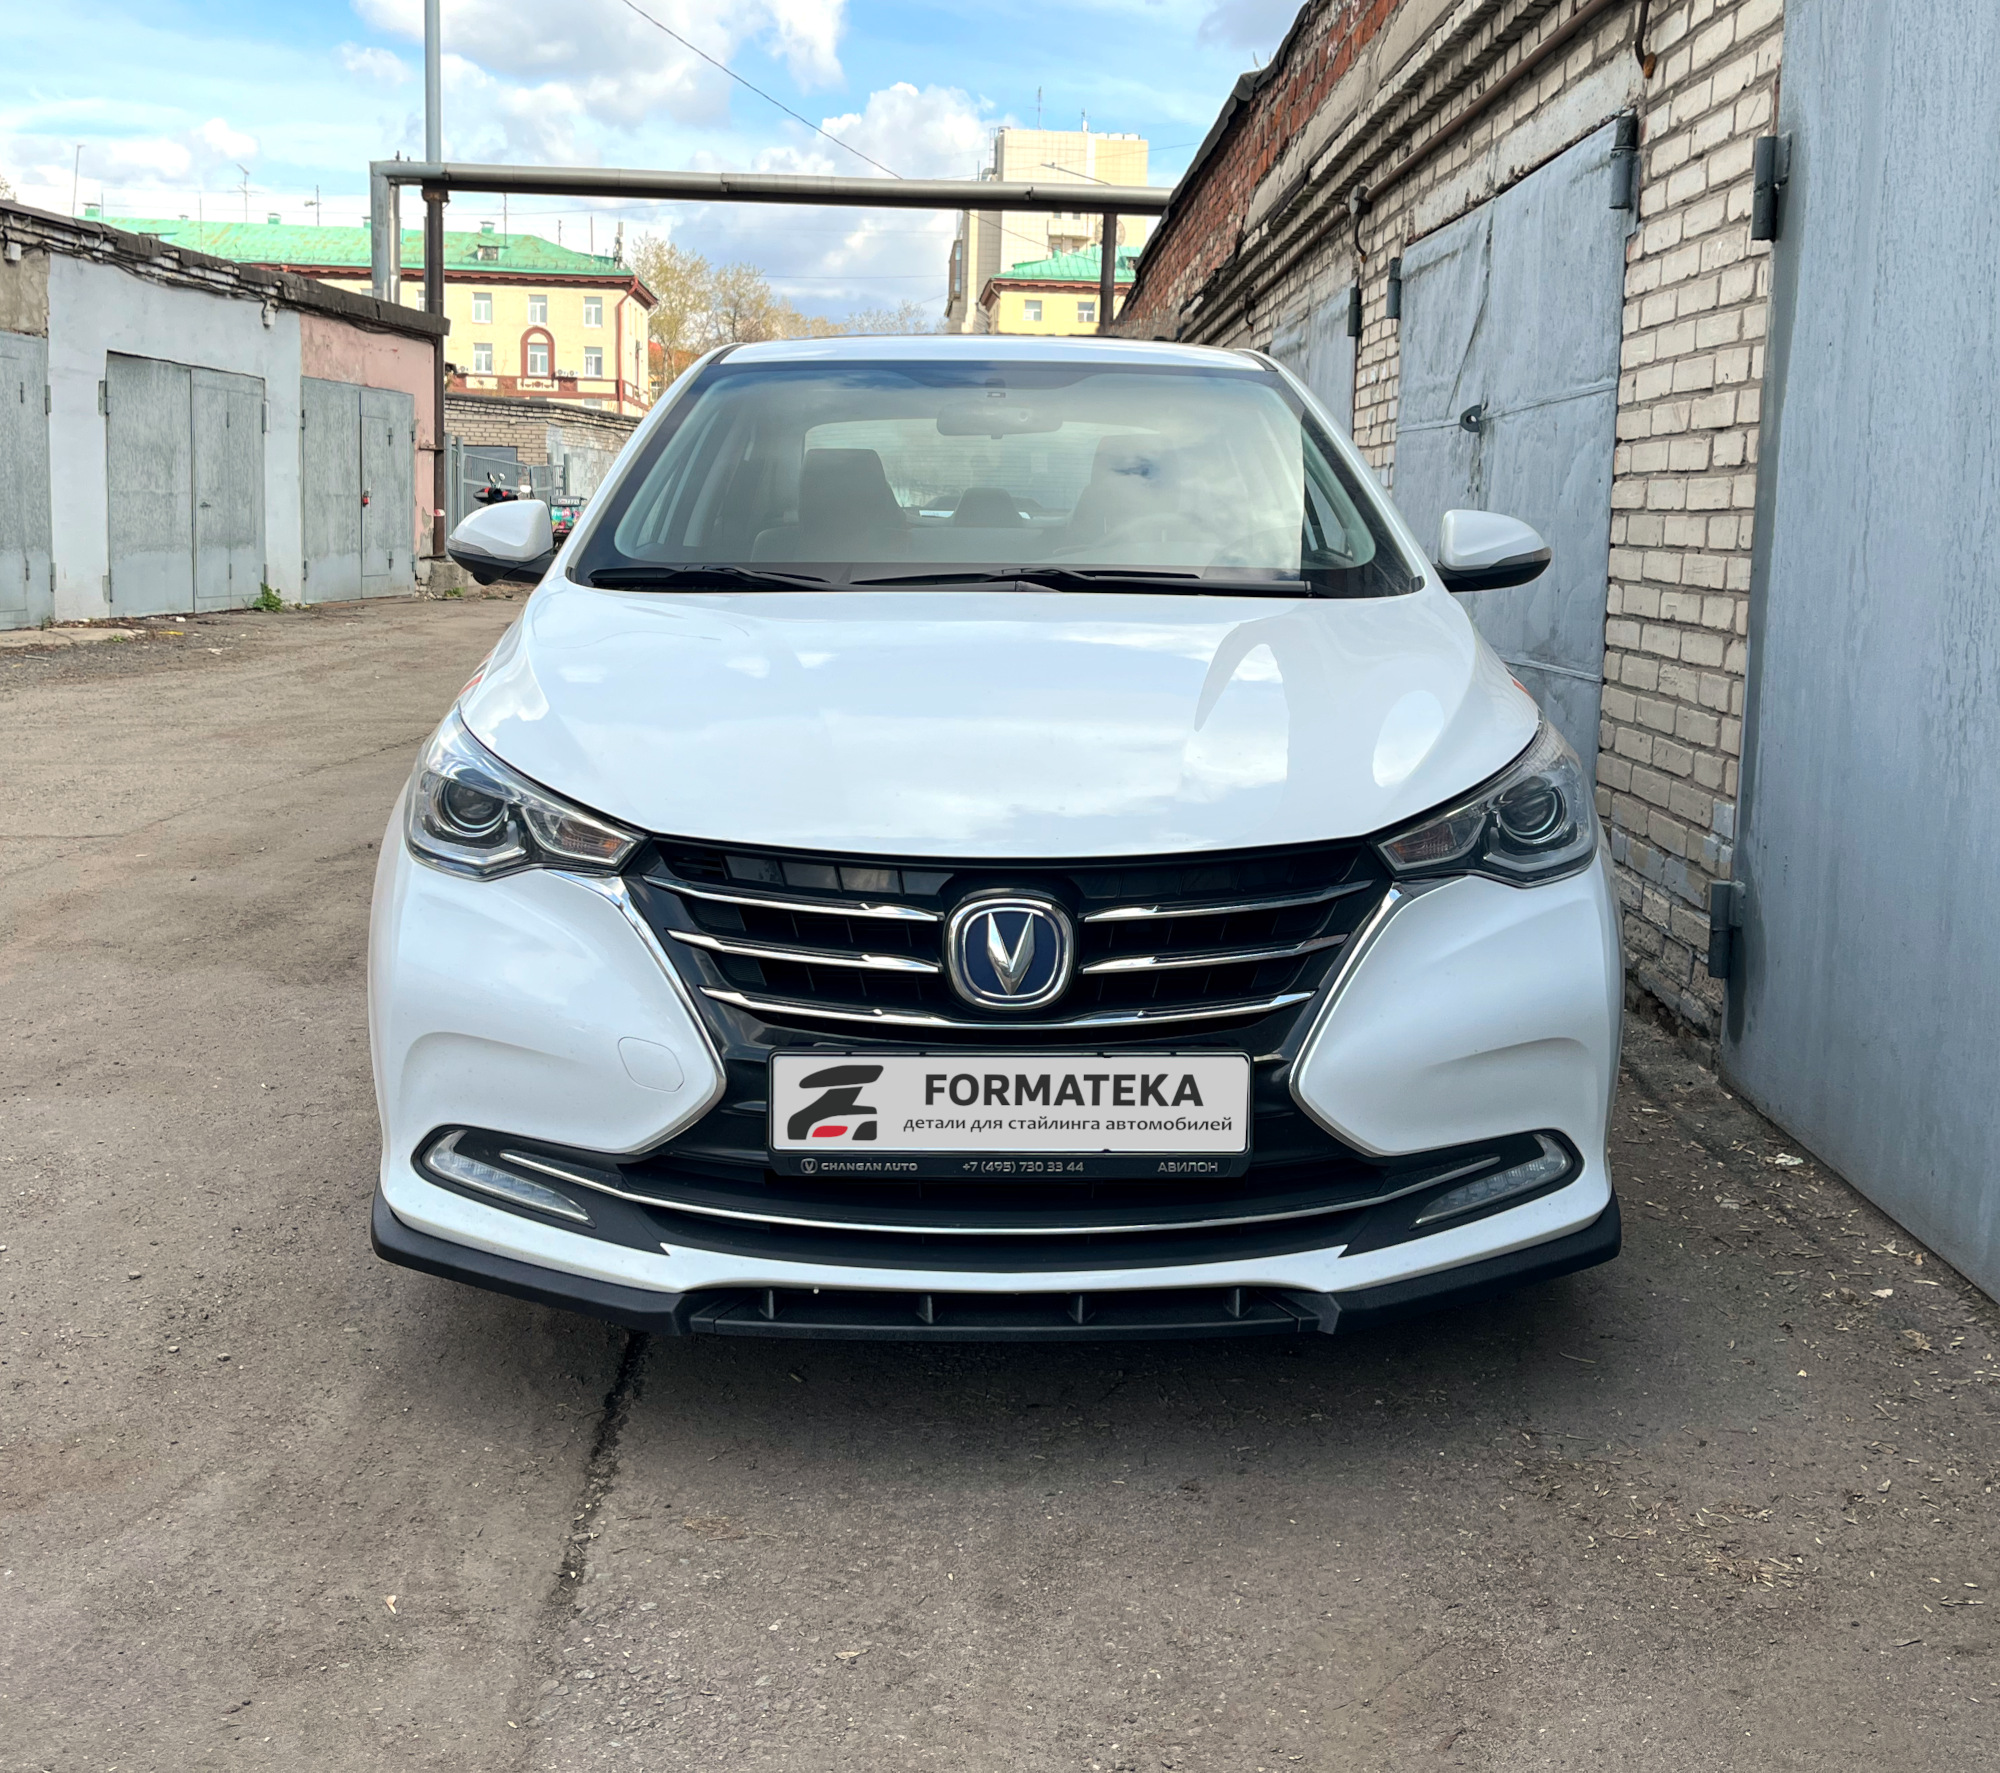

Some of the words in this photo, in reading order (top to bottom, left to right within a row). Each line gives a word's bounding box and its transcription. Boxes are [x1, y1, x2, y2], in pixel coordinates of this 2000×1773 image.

[924, 1073, 1204, 1106] FORMATEKA
[903, 1118, 966, 1132] детали
[970, 1118, 1003, 1133] для
[1008, 1116, 1100, 1130] стайлинга
[1105, 1116, 1233, 1131] автомобилей
[821, 1162, 882, 1171] CHANGAN
[884, 1162, 918, 1171] AUTO
[962, 1162, 978, 1172] +7
[980, 1161, 1016, 1173] (495)
[1019, 1162, 1044, 1172] 730
[1046, 1162, 1063, 1172] 33
[1066, 1162, 1084, 1172] 44
[1157, 1162, 1218, 1173] АВИЛОН
